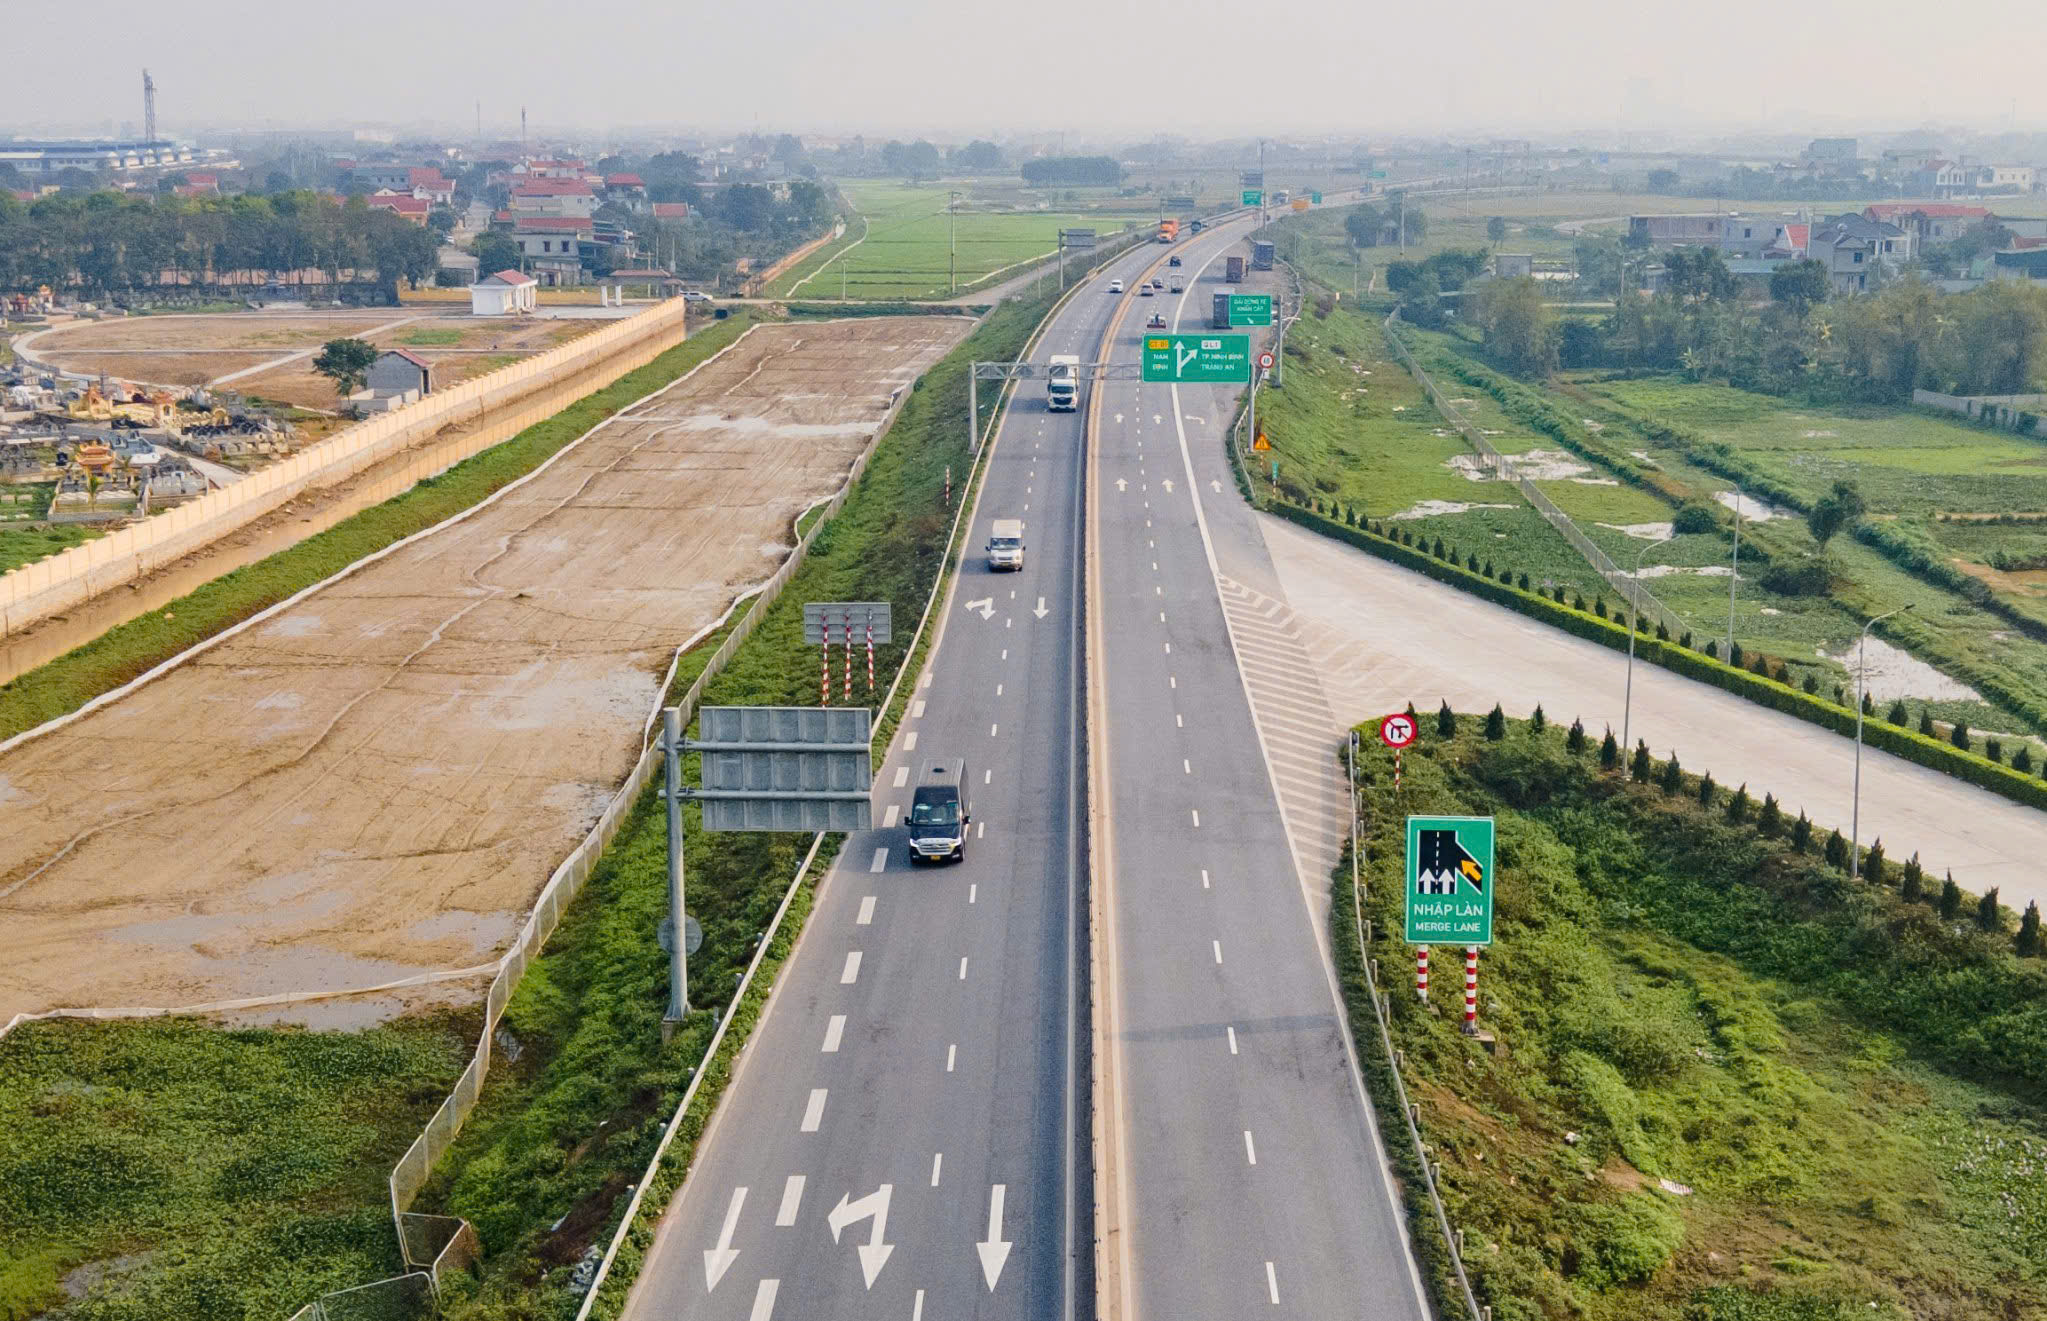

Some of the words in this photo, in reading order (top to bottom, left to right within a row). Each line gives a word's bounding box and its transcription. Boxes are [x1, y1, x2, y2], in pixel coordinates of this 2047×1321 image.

[1414, 902, 1452, 918] NHẬP
[1456, 901, 1483, 916] LÀN
[1416, 922, 1451, 932] MERGE
[1454, 922, 1481, 932] LANE
